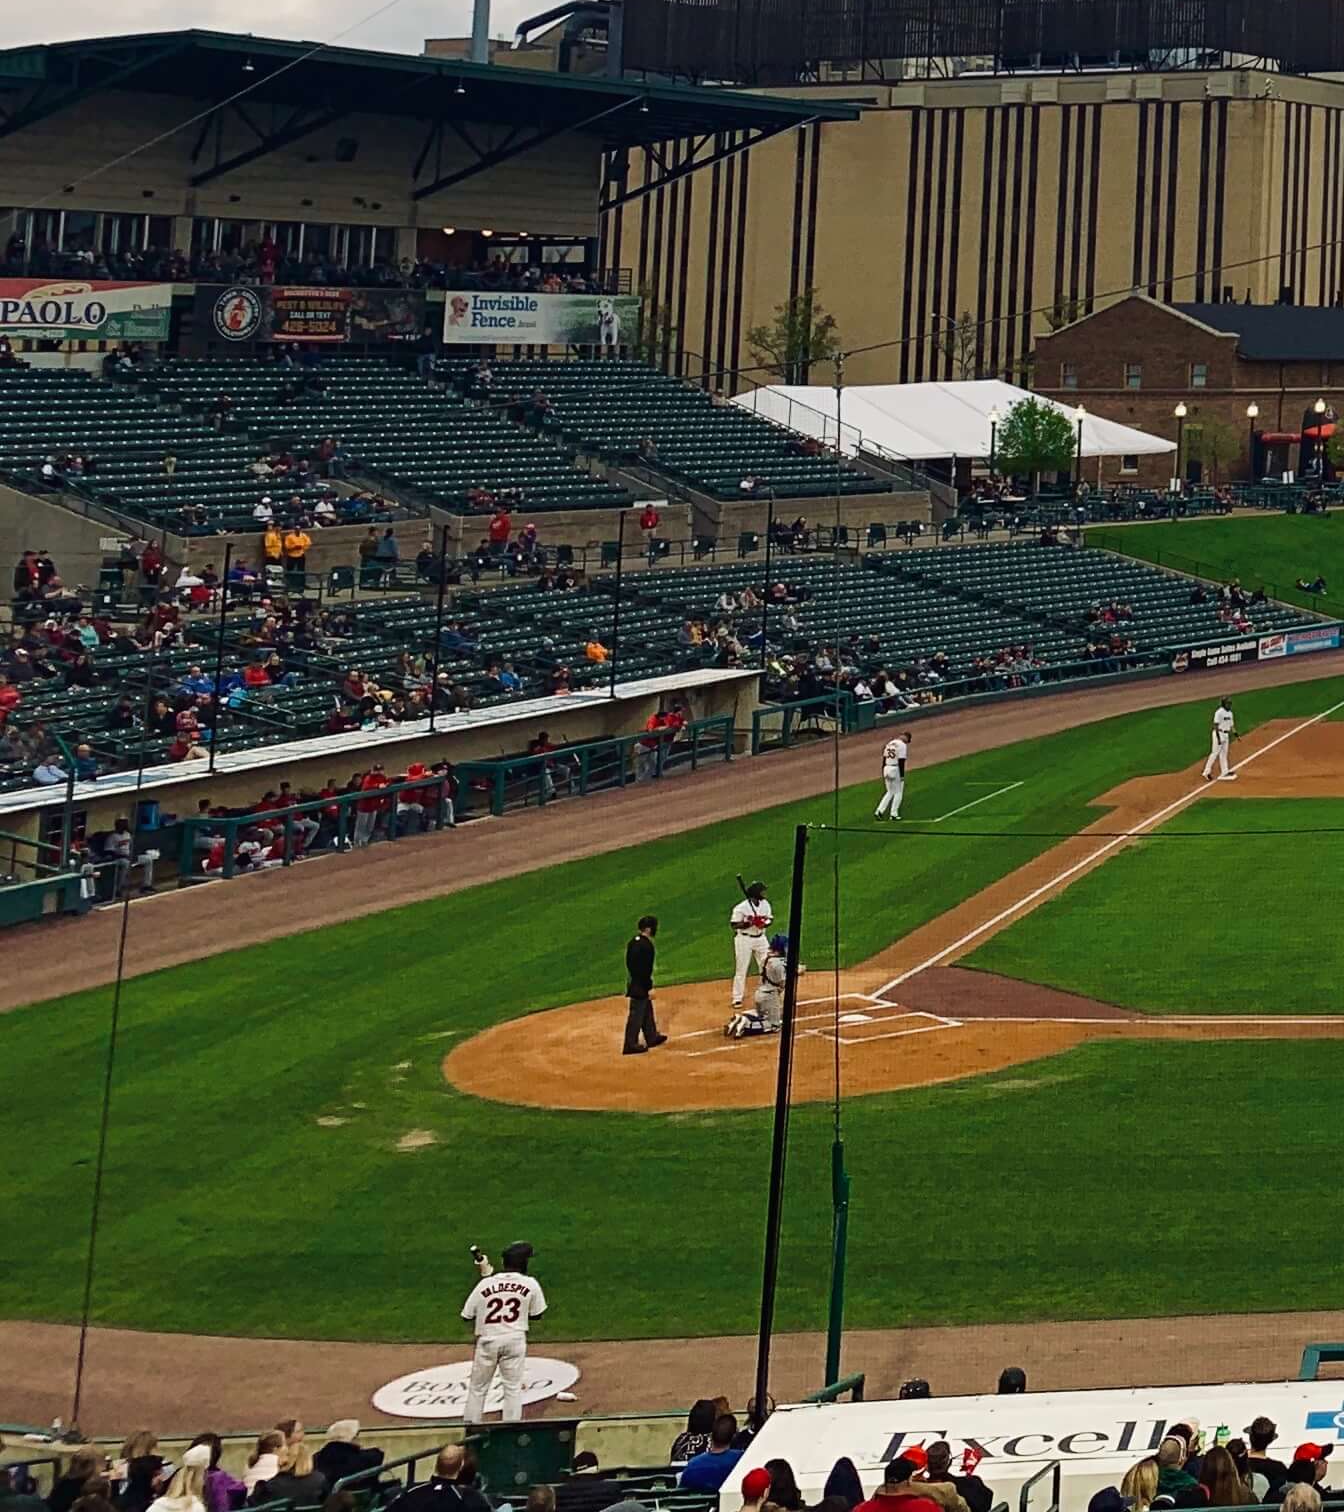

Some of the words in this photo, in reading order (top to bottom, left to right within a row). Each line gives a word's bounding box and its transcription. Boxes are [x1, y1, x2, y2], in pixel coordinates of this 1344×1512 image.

[471, 295, 538, 312] Invisible
[470, 312, 515, 328] Fence
[480, 1281, 531, 1298] VALDESPIN
[484, 1297, 521, 1324] 23
